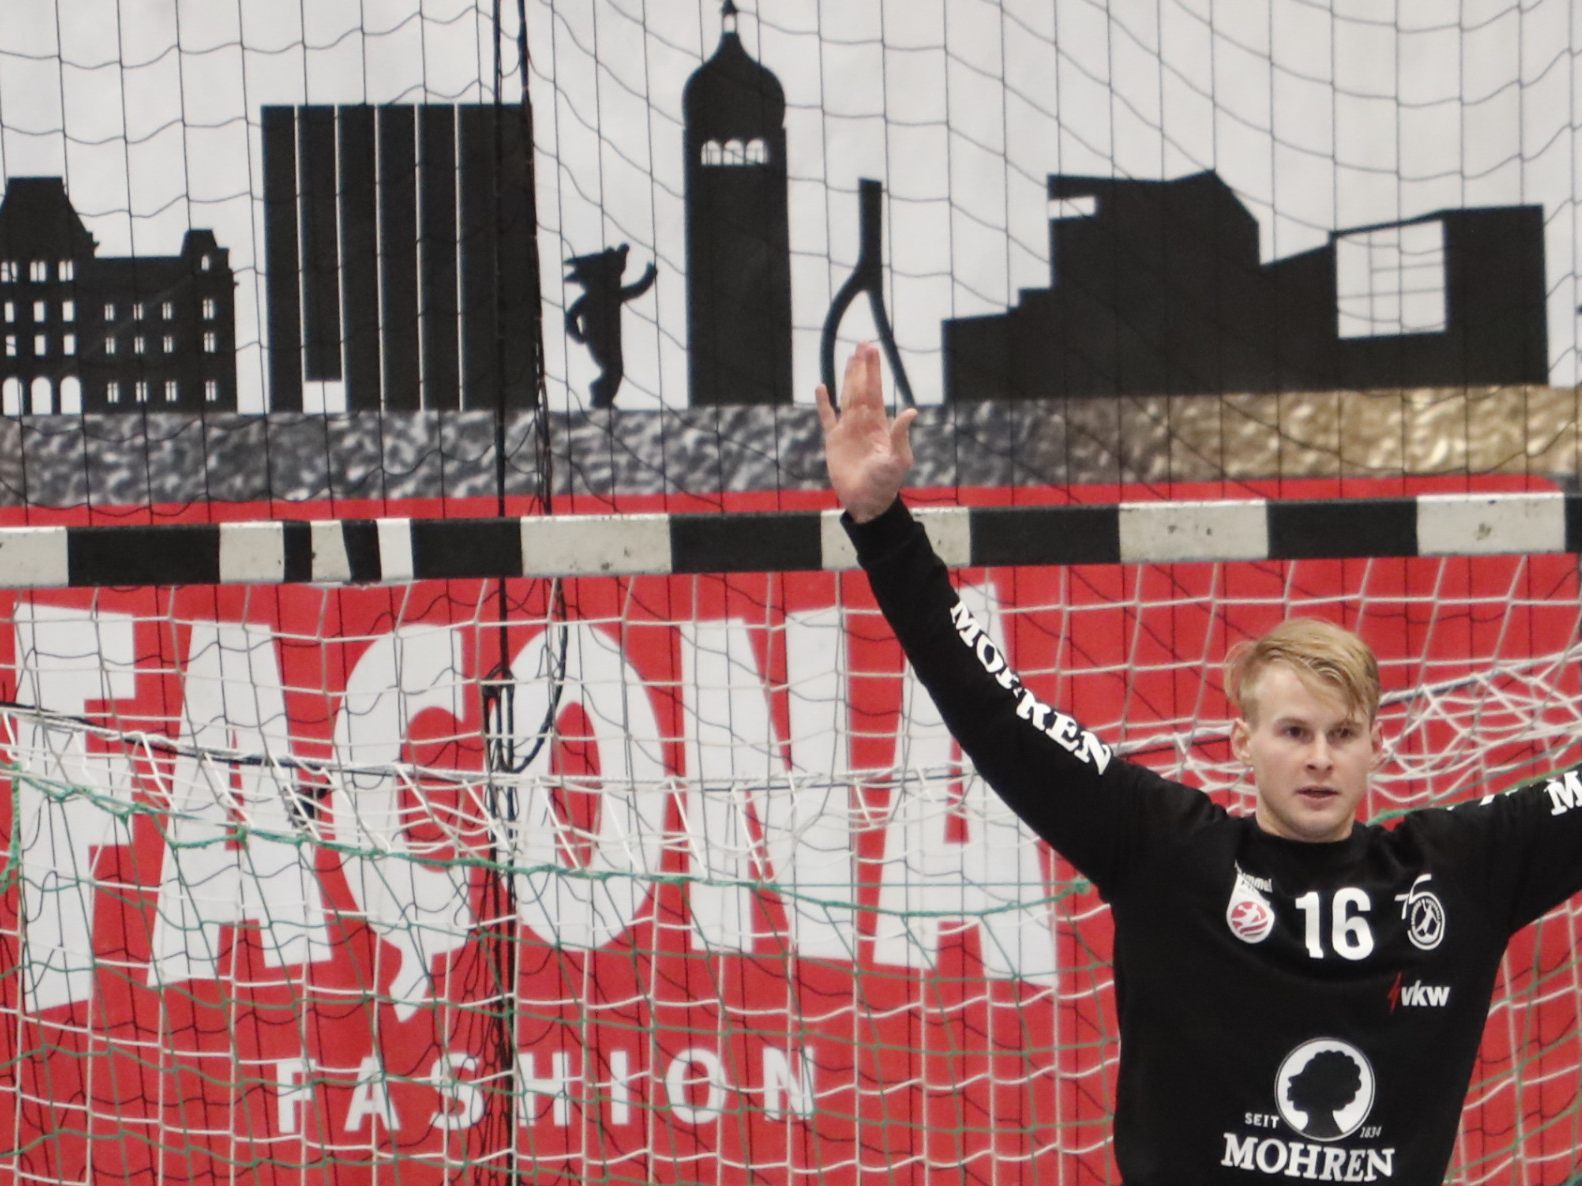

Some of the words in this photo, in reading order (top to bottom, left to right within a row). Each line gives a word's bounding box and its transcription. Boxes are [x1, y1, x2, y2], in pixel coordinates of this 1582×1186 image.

[1295, 887, 1374, 960] 16
[1401, 980, 1451, 1007] vkw
[276, 1044, 817, 1134] FASHION
[1244, 1112, 1280, 1129] SEIT
[1220, 1132, 1396, 1182] MOHREN
